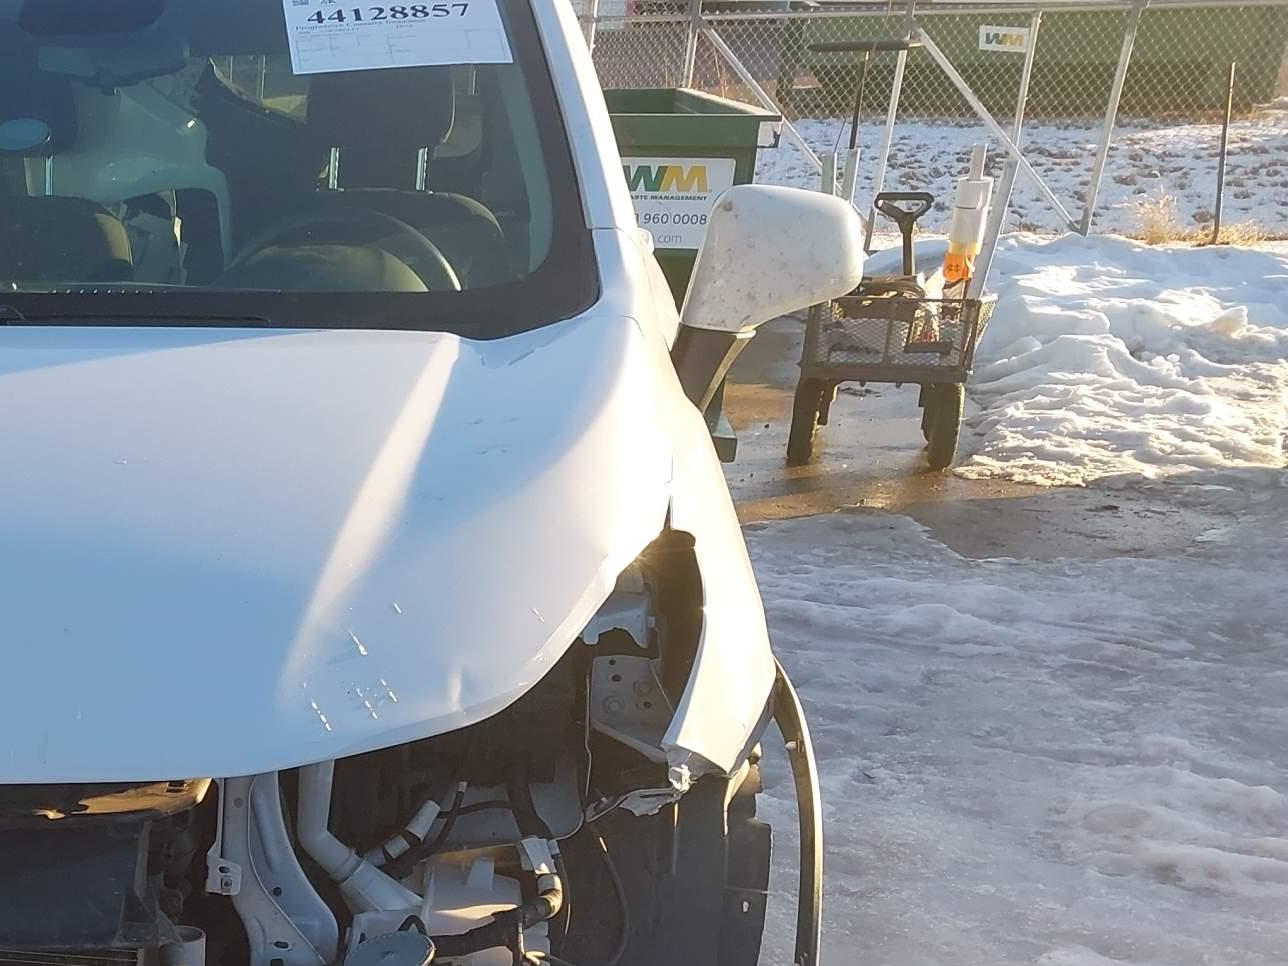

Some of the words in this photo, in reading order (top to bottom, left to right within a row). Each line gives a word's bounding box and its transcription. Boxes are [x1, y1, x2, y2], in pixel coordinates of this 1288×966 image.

[307, 3, 469, 24] 44128857
[985, 32, 1024, 47] WM
[623, 166, 707, 192] WM
[643, 213, 669, 225] 960
[672, 214, 708, 225] 0008
